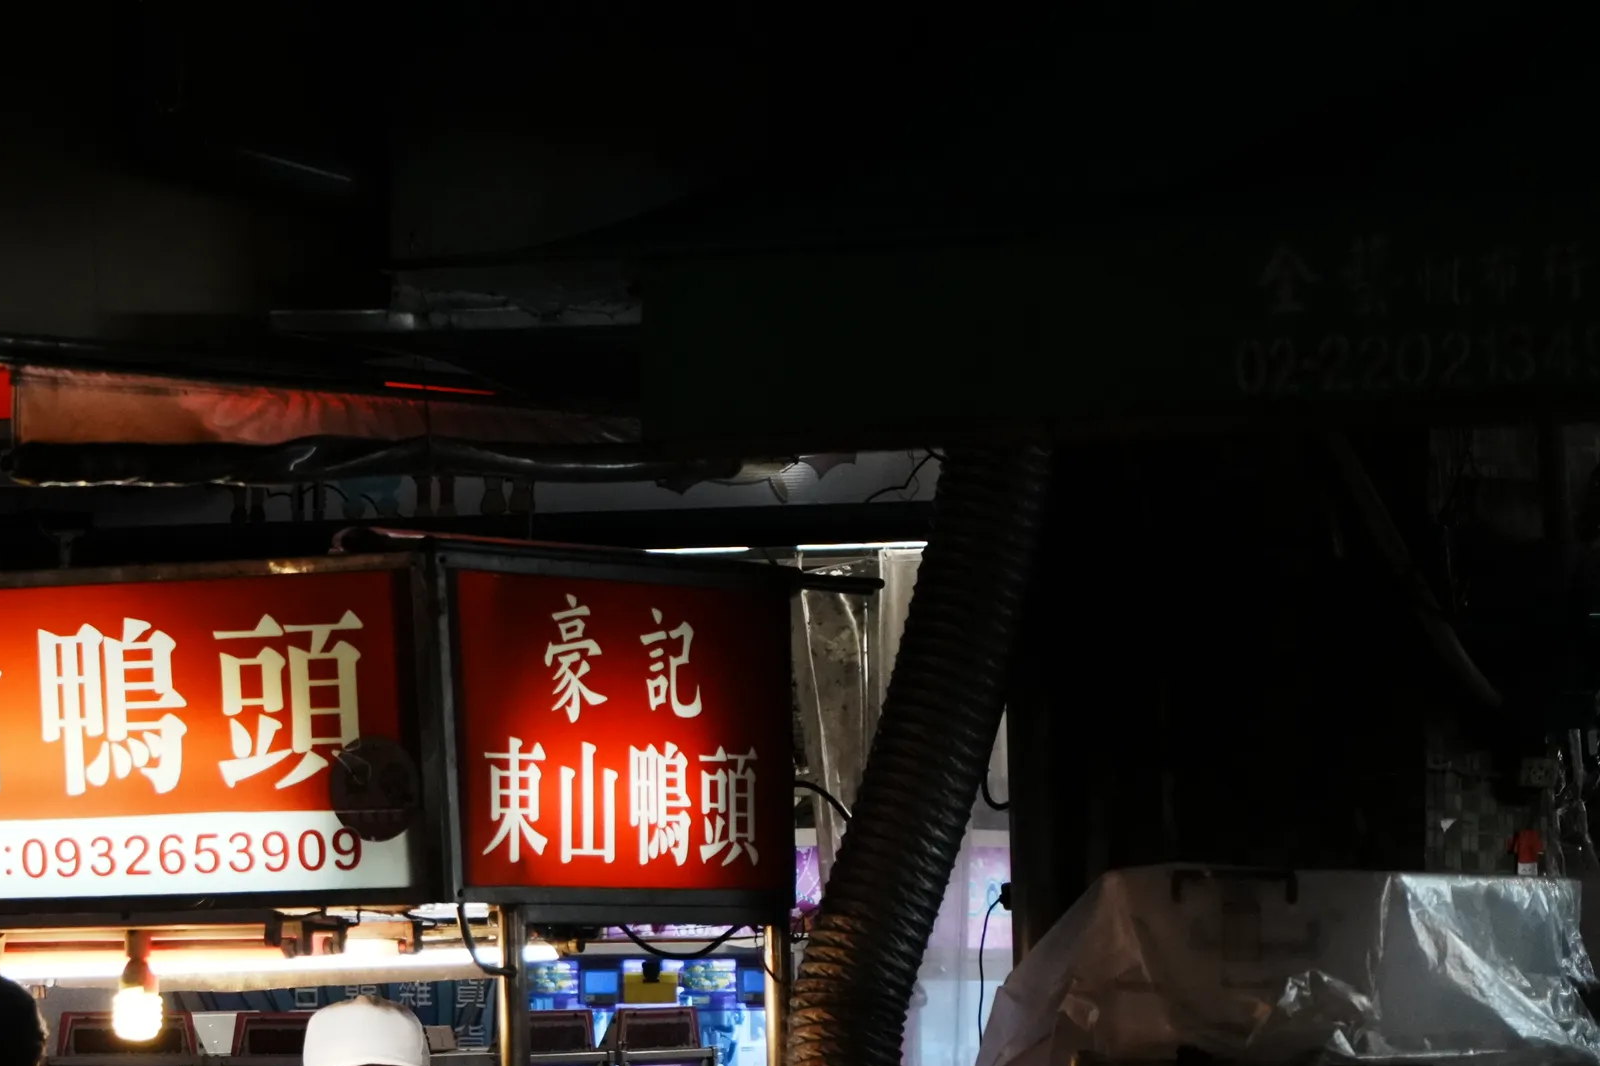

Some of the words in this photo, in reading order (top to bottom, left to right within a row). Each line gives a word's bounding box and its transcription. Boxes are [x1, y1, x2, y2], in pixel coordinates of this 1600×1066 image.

[543, 593, 703, 724] 豪記
[482, 736, 761, 868] 東山鴨頭
